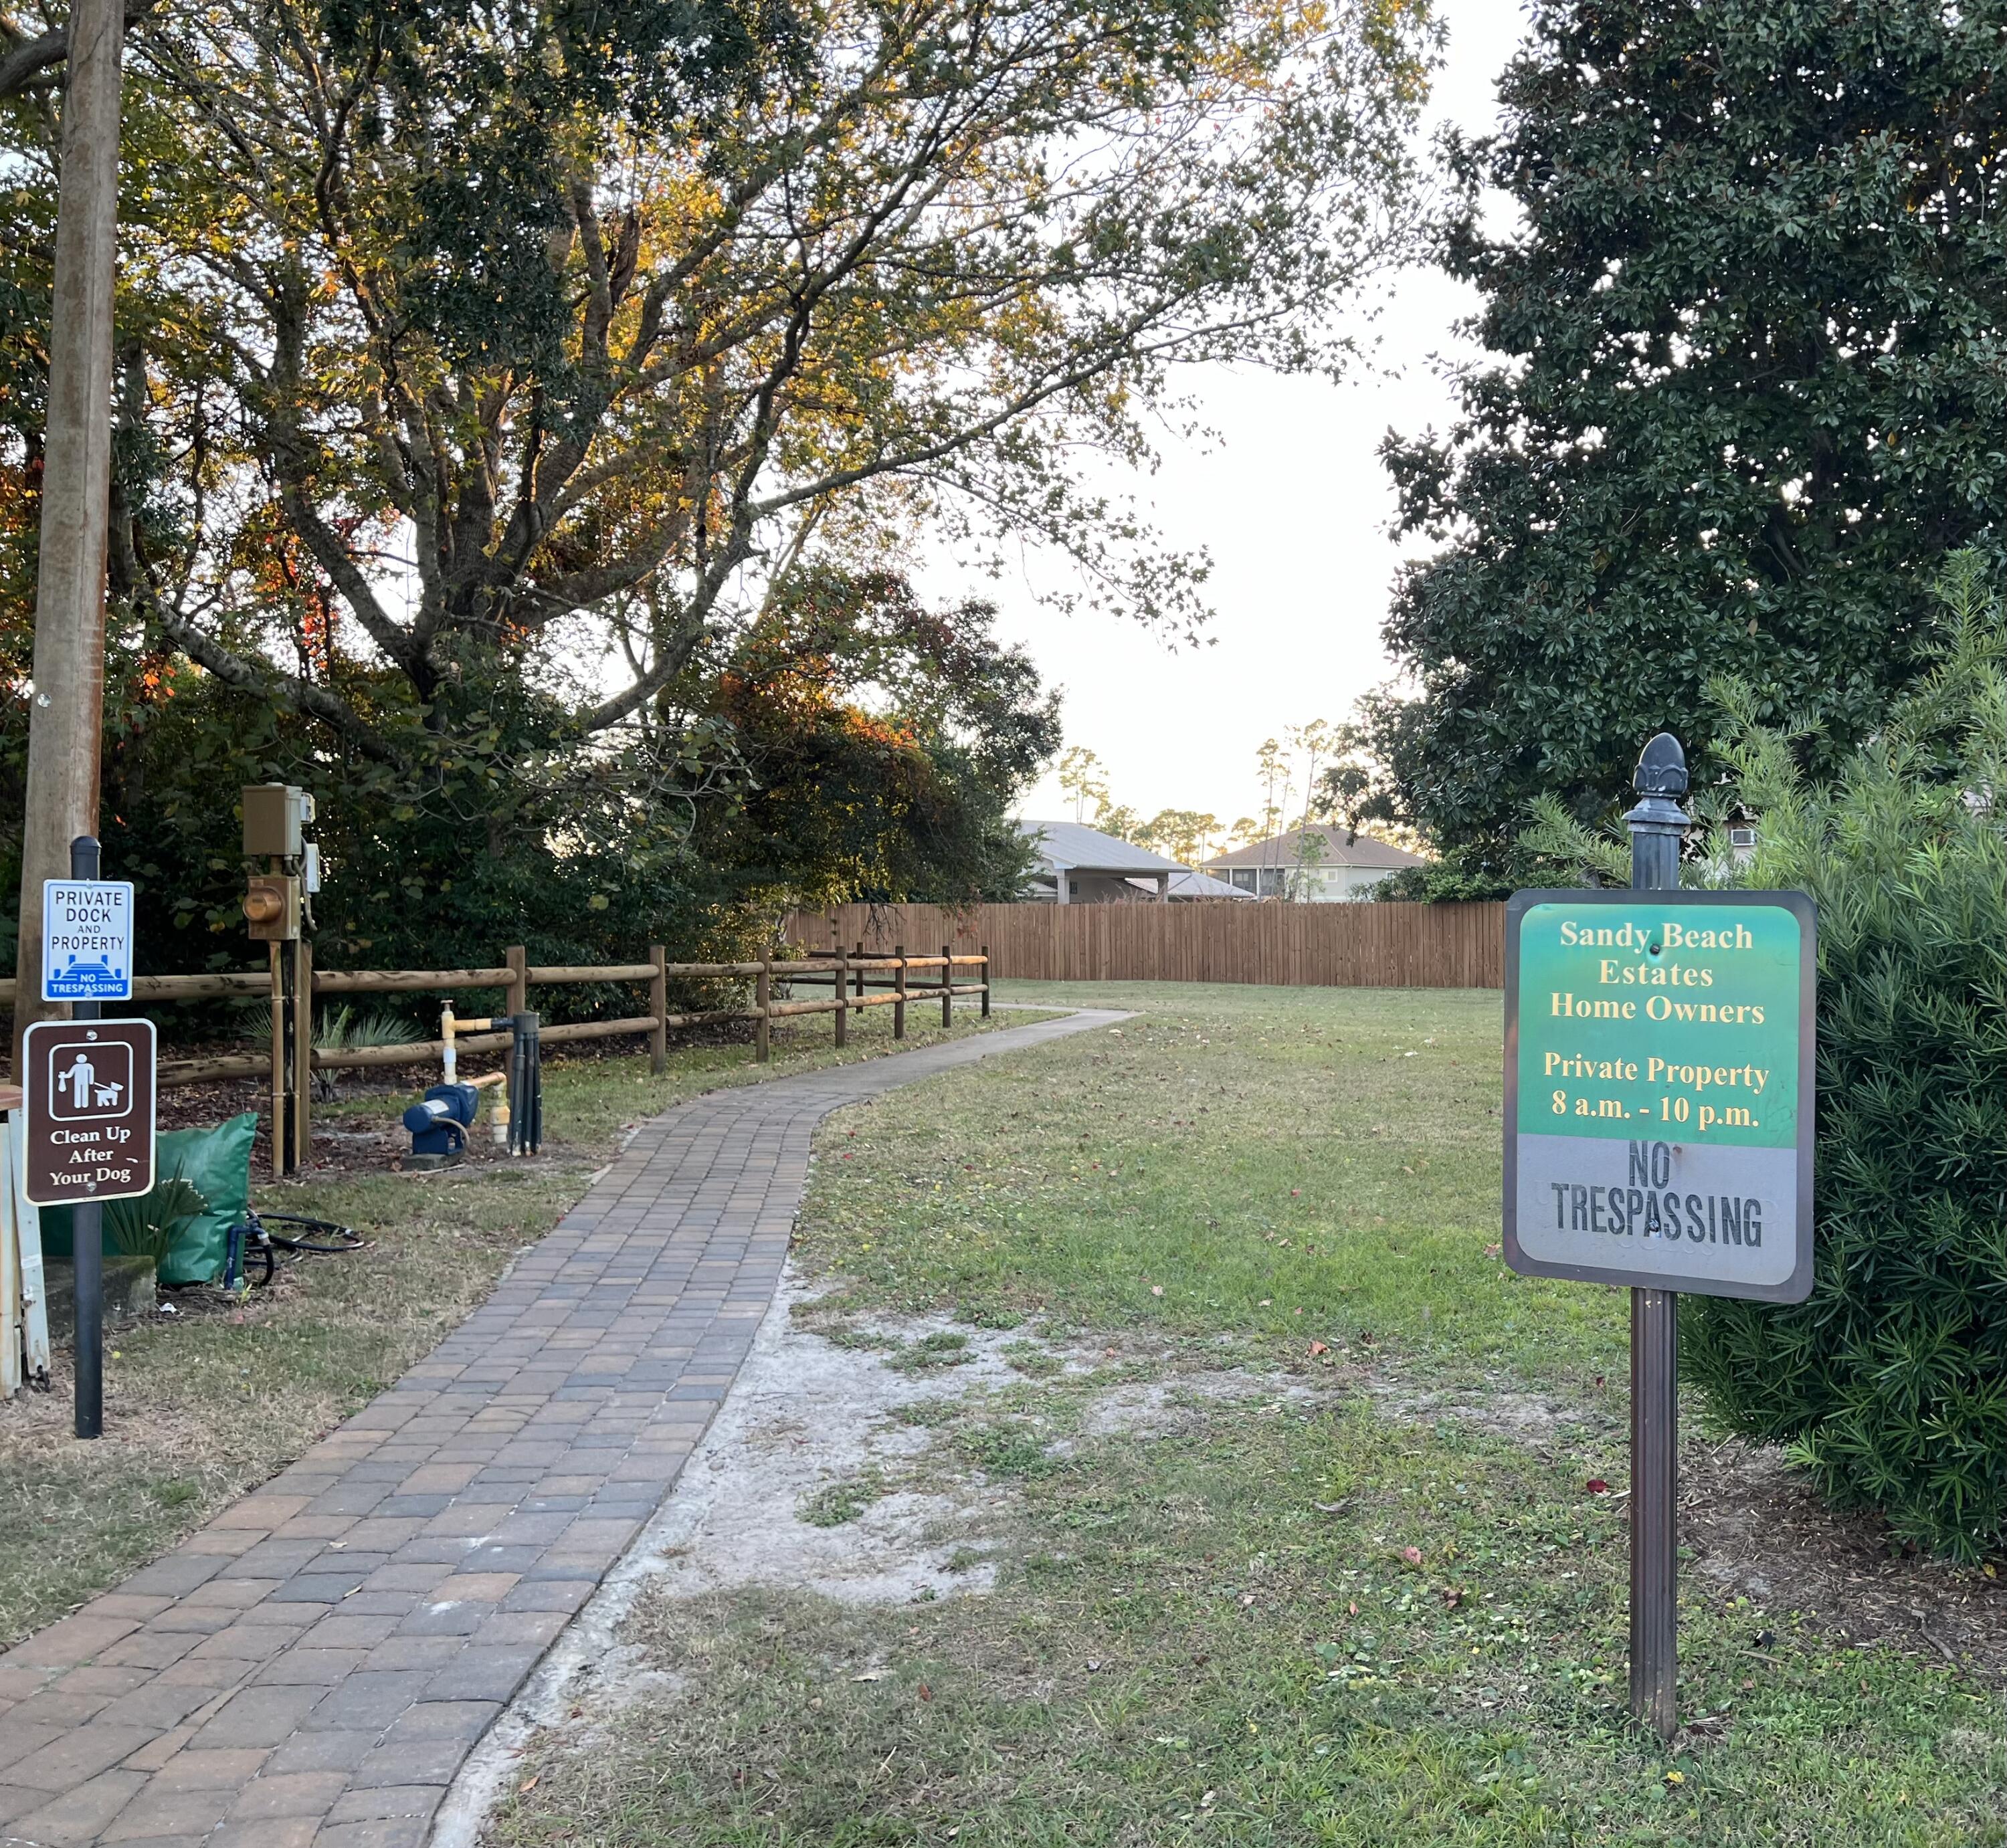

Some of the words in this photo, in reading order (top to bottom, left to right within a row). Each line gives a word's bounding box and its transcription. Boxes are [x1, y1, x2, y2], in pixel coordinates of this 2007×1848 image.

[56, 892, 122, 906] PRIVATE
[66, 908, 112, 922] DOCK
[78, 925, 101, 934] AND
[1560, 920, 1651, 954] Sandy
[1662, 923, 1753, 949] Beach
[52, 936, 124, 950] PROPERTY
[80, 974, 96, 983] NO
[1599, 960, 1713, 987] Estates
[52, 984, 123, 993] TRESPASSING
[1550, 993, 1636, 1020] Home
[1646, 996, 1765, 1025] Owners
[1544, 1052, 1638, 1081] Private
[1646, 1057, 1770, 1094] Property
[1551, 1090, 1567, 1115] 8
[1575, 1097, 1631, 1119] a.m.
[1659, 1097, 1690, 1123] 10
[1699, 1106, 1759, 1131] p.m.
[50, 1129, 100, 1144] Clean
[106, 1126, 130, 1143] Up
[68, 1148, 113, 1163] After
[1629, 1140, 1670, 1189] NO
[50, 1171, 91, 1186] Your
[96, 1168, 131, 1184] Dog
[1551, 1183, 1761, 1247] TRESPASSING
